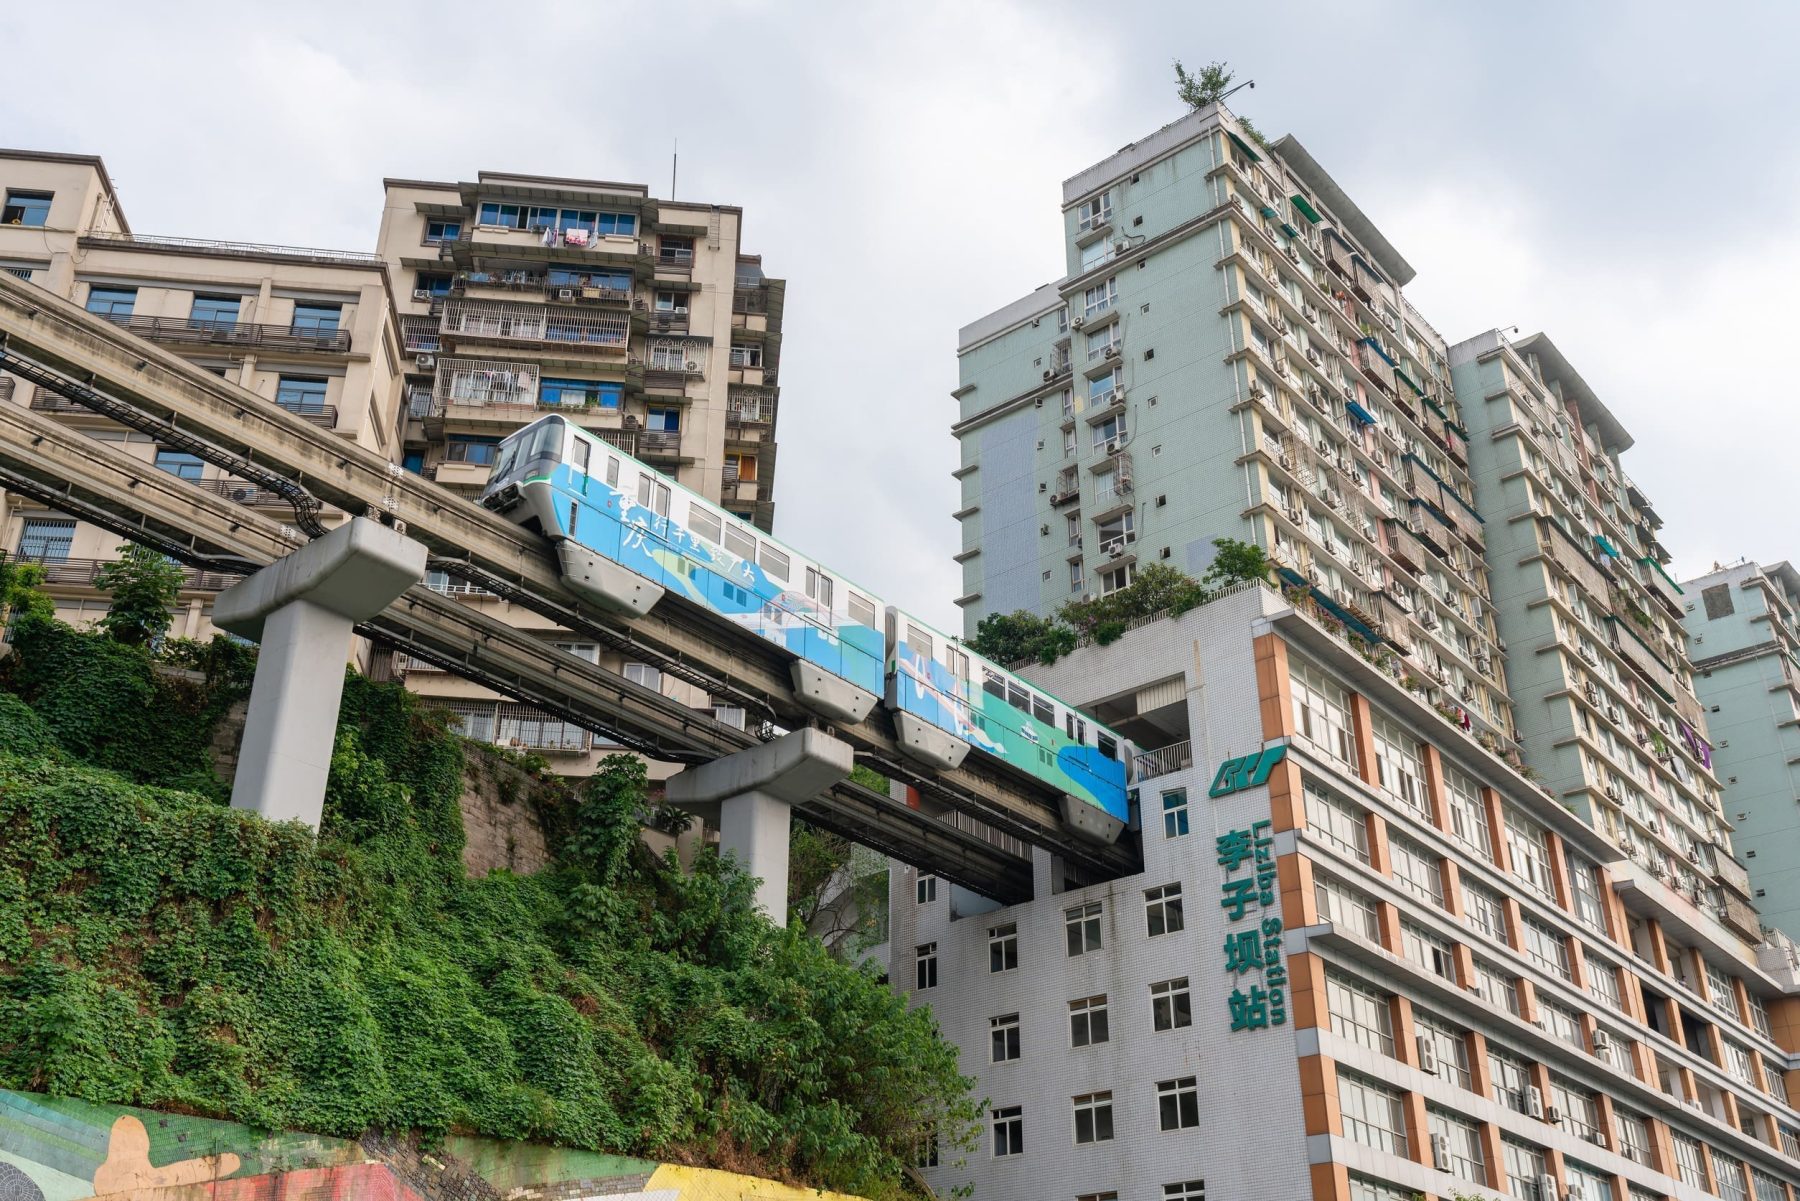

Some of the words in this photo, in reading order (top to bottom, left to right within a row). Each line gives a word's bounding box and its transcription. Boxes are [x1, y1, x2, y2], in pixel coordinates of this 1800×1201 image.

[1252, 819, 1276, 907] Liziba
[1216, 829, 1269, 1032] 李子坝站
[1261, 917, 1287, 1025] Station
